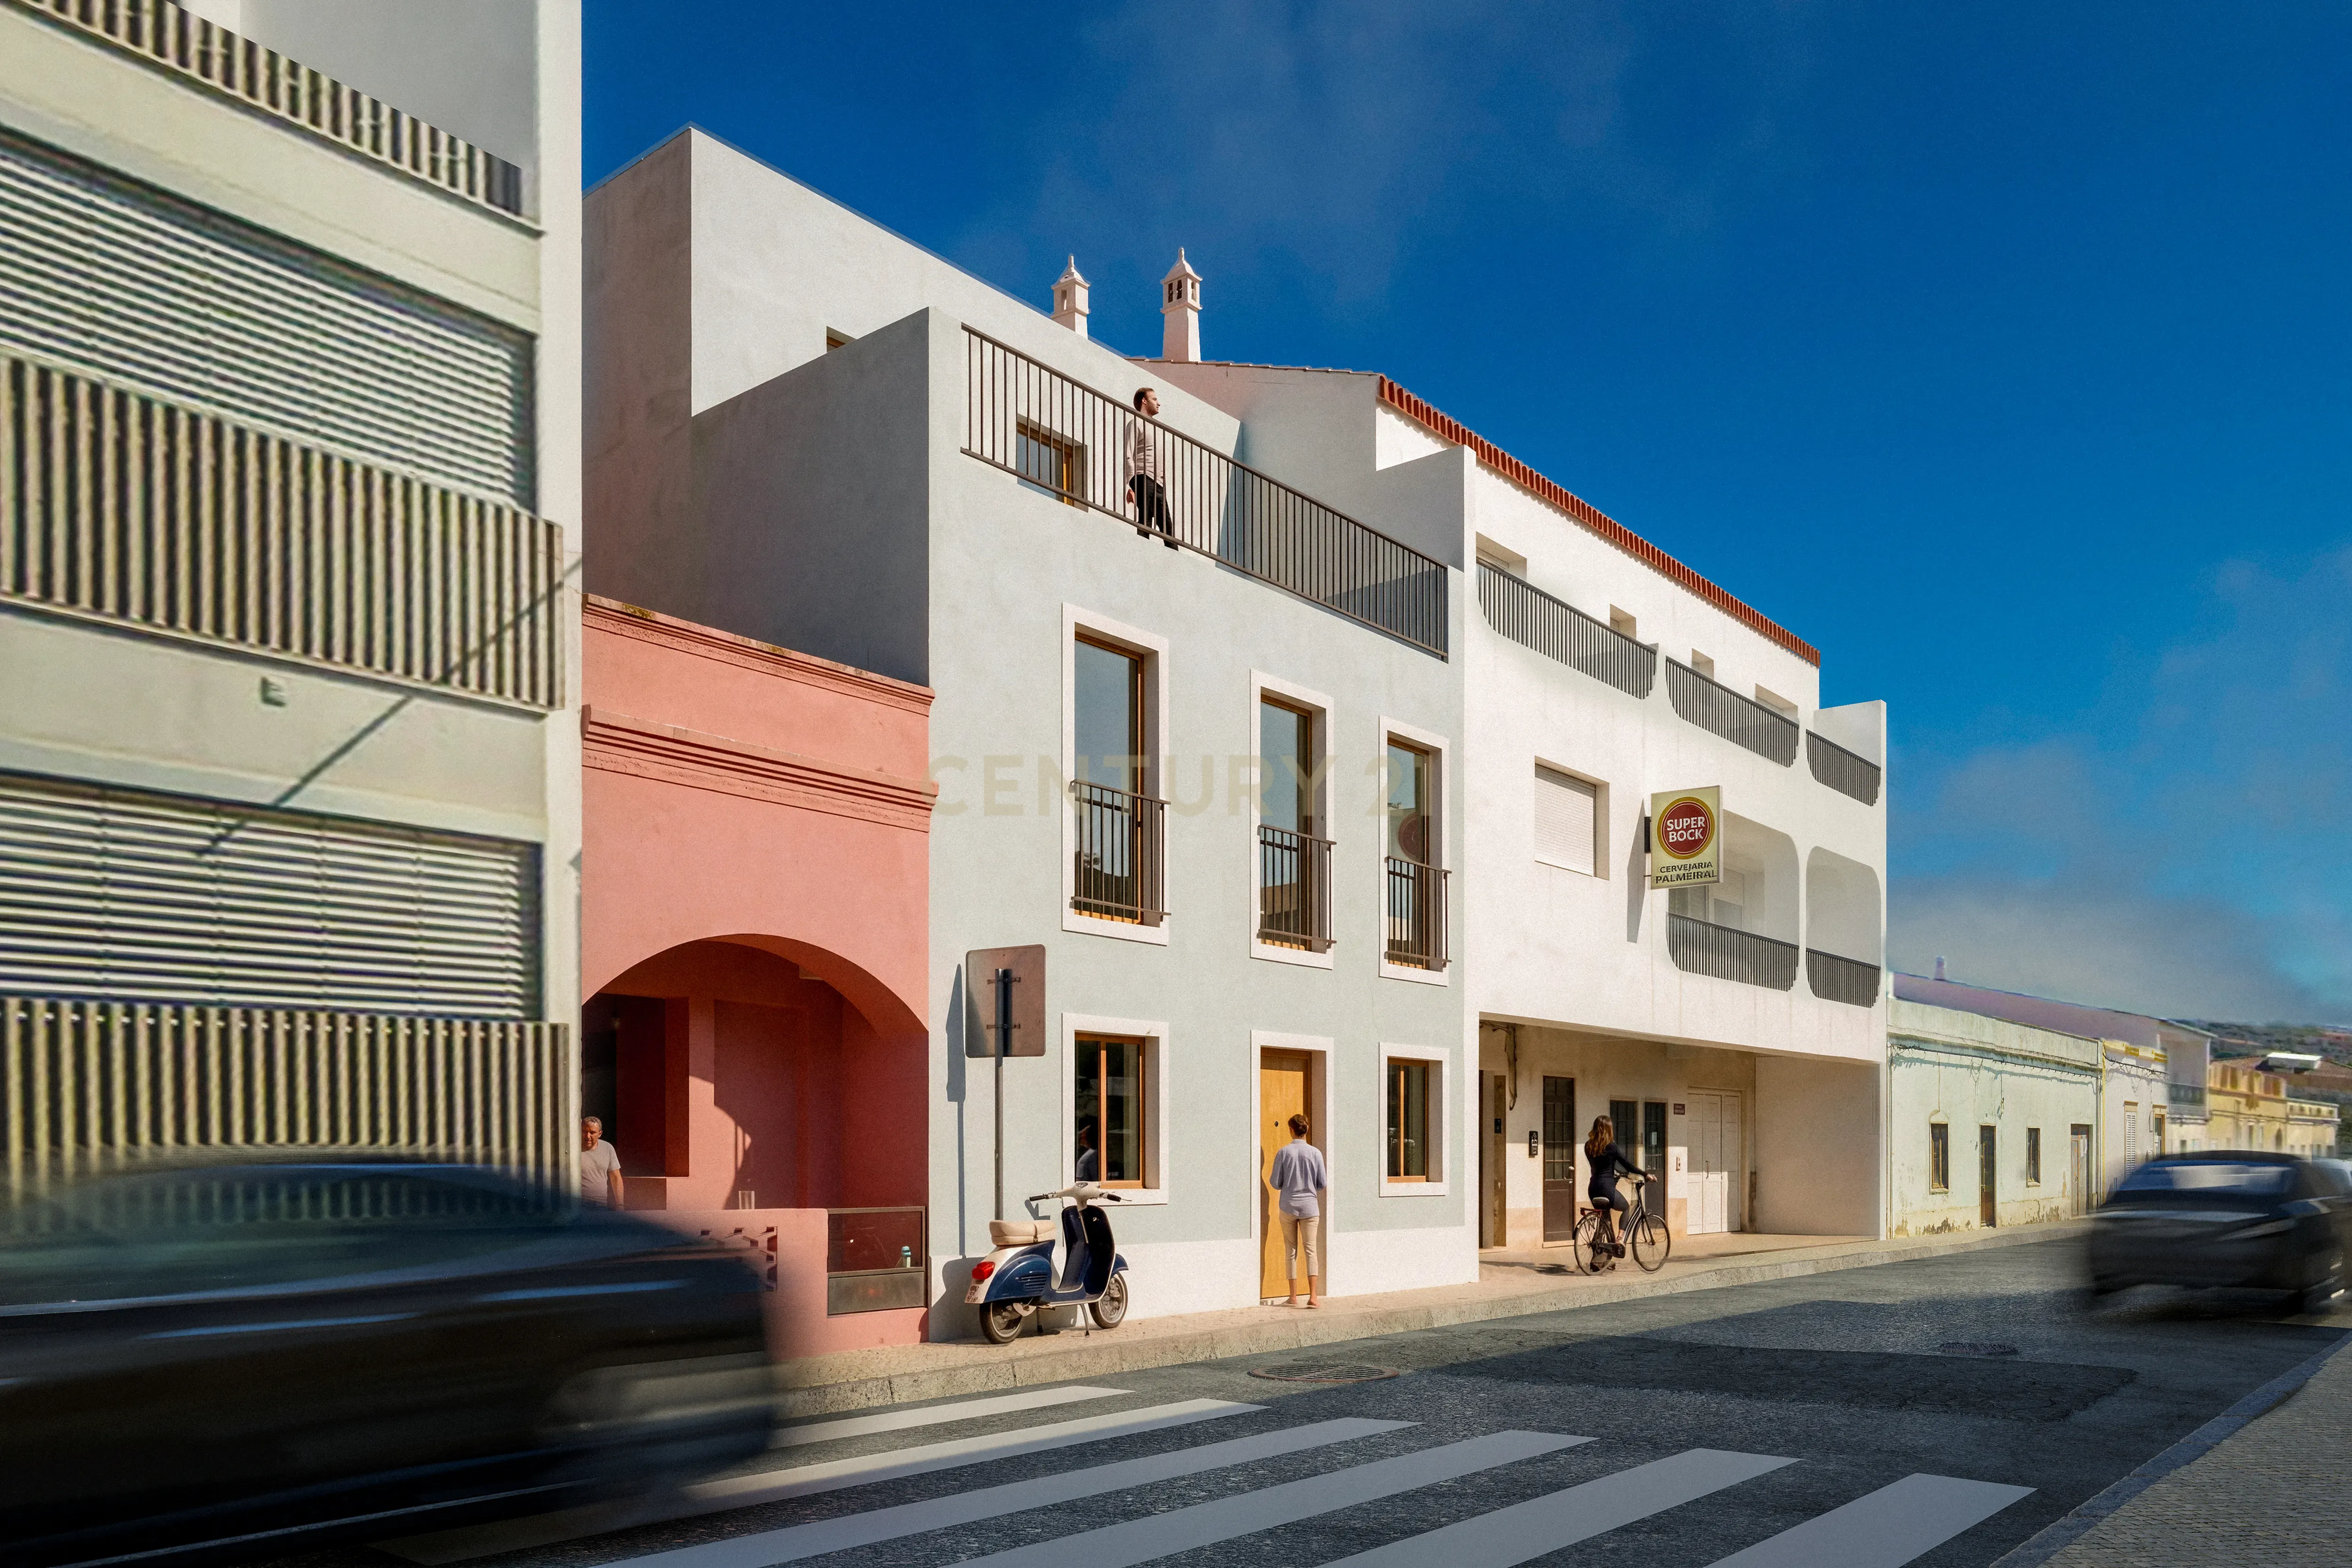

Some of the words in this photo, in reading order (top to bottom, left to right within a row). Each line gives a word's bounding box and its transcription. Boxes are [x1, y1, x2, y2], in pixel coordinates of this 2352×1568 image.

[1667, 816, 1705, 831] SUPER
[1669, 828, 1703, 843] BOCK
[1660, 861, 1713, 873] CERVEJARIA
[1655, 869, 1717, 884] PALMEIRAL
